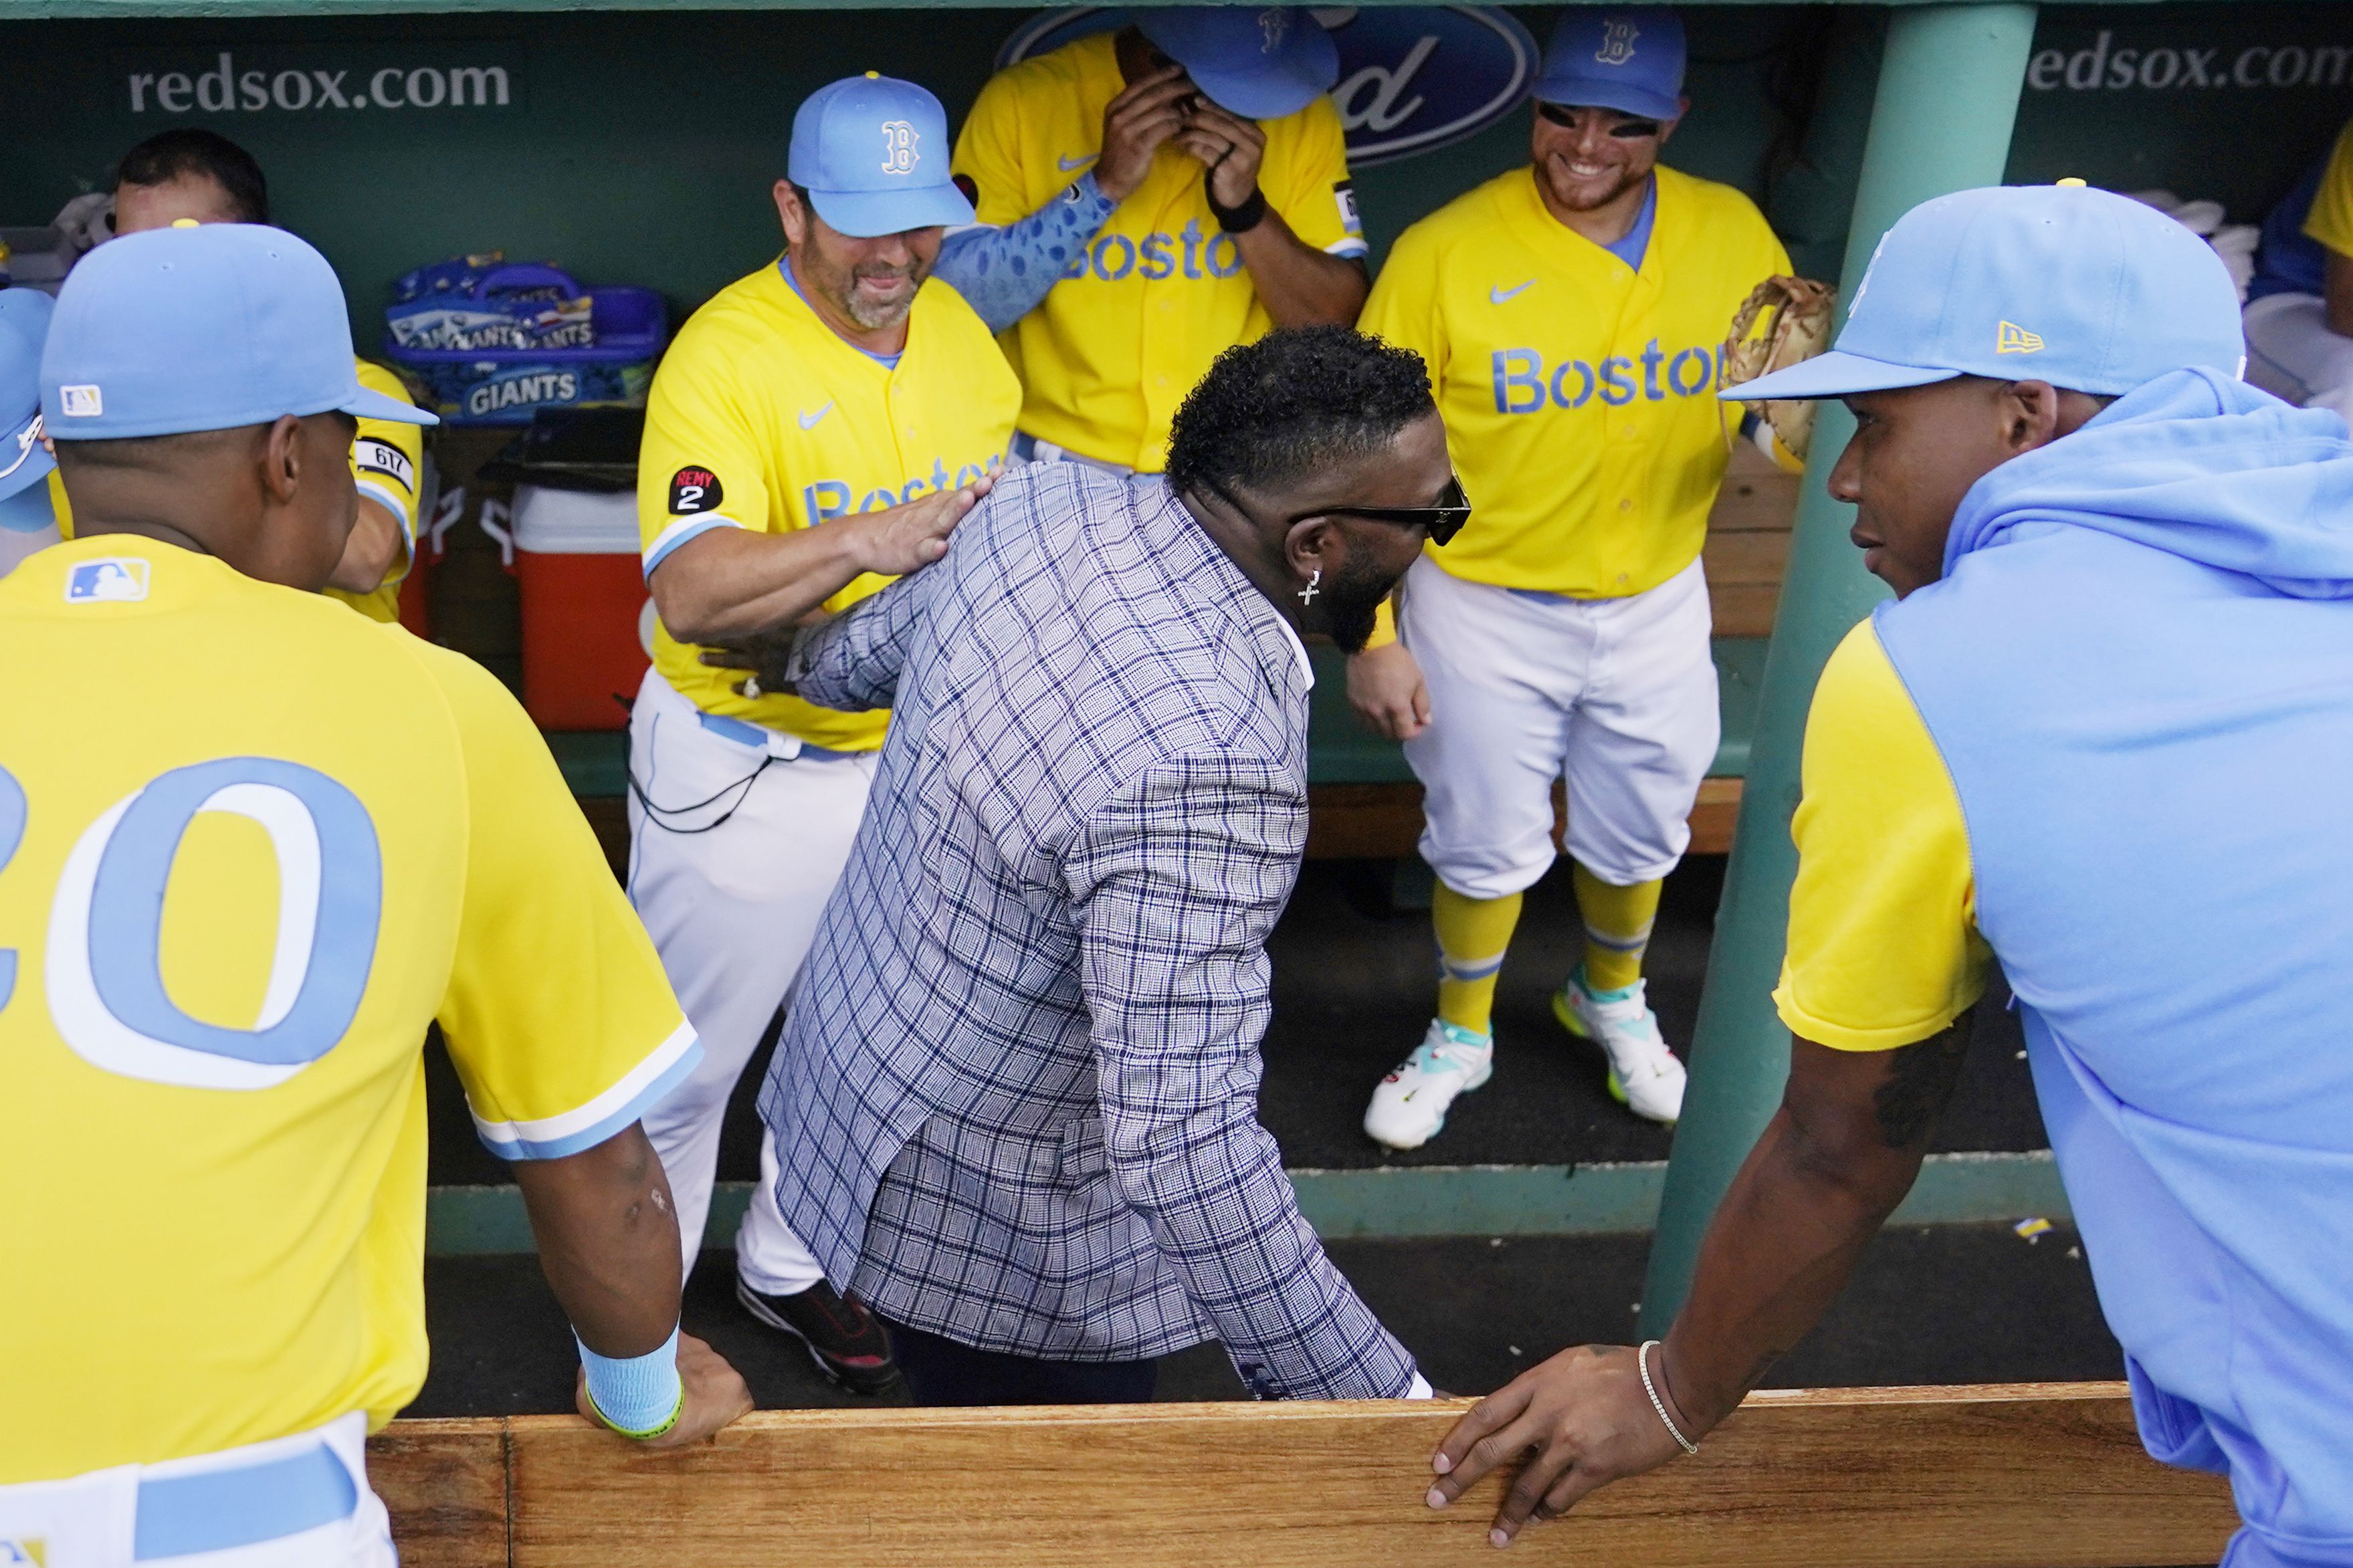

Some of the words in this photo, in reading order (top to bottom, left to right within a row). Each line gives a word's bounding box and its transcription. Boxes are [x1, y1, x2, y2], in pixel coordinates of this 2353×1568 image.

[1596, 19, 1641, 65] B
[2027, 30, 2353, 90] edsox.com
[129, 52, 510, 112] redsox.com
[882, 120, 920, 174] B
[1062, 217, 1246, 281] osto
[470, 372, 576, 416] GIANTS
[375, 447, 403, 473] 617
[676, 470, 714, 489] REMY
[677, 485, 704, 510] 2
[0, 755, 383, 1093] 0
